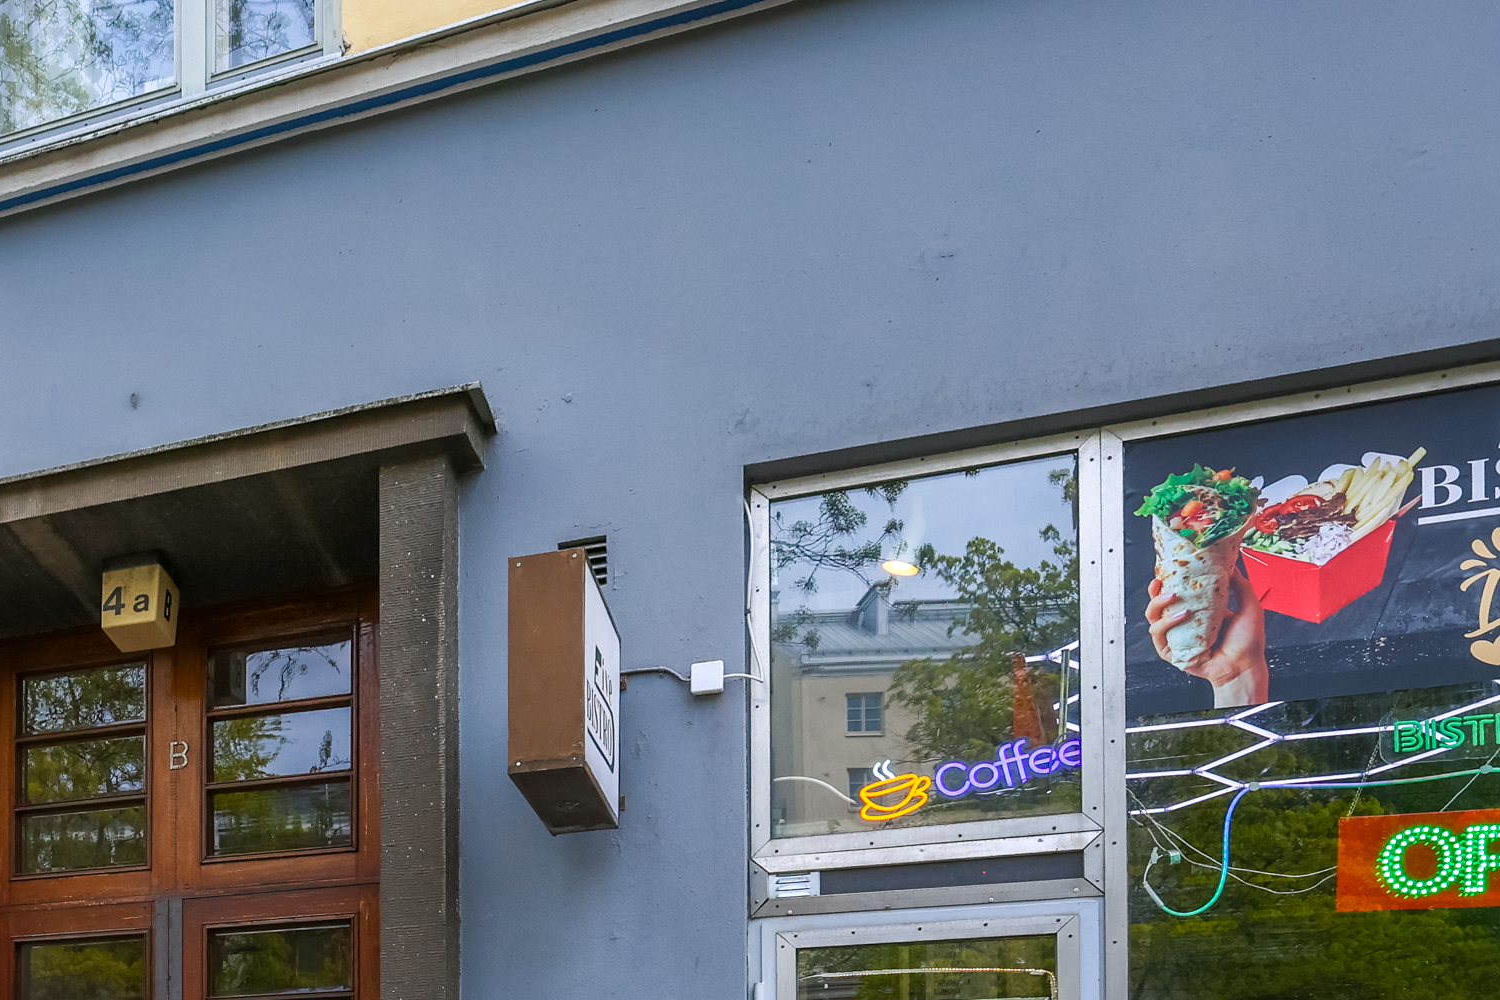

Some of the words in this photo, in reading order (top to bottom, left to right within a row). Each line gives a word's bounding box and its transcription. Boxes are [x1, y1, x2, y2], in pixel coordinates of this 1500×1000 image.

[1417, 458, 1500, 509] BI
[164, 589, 172, 622] B
[586, 678, 612, 757] BISTRO
[1394, 713, 1500, 752] BIST
[169, 741, 189, 770] B
[935, 738, 1081, 797] Coffee
